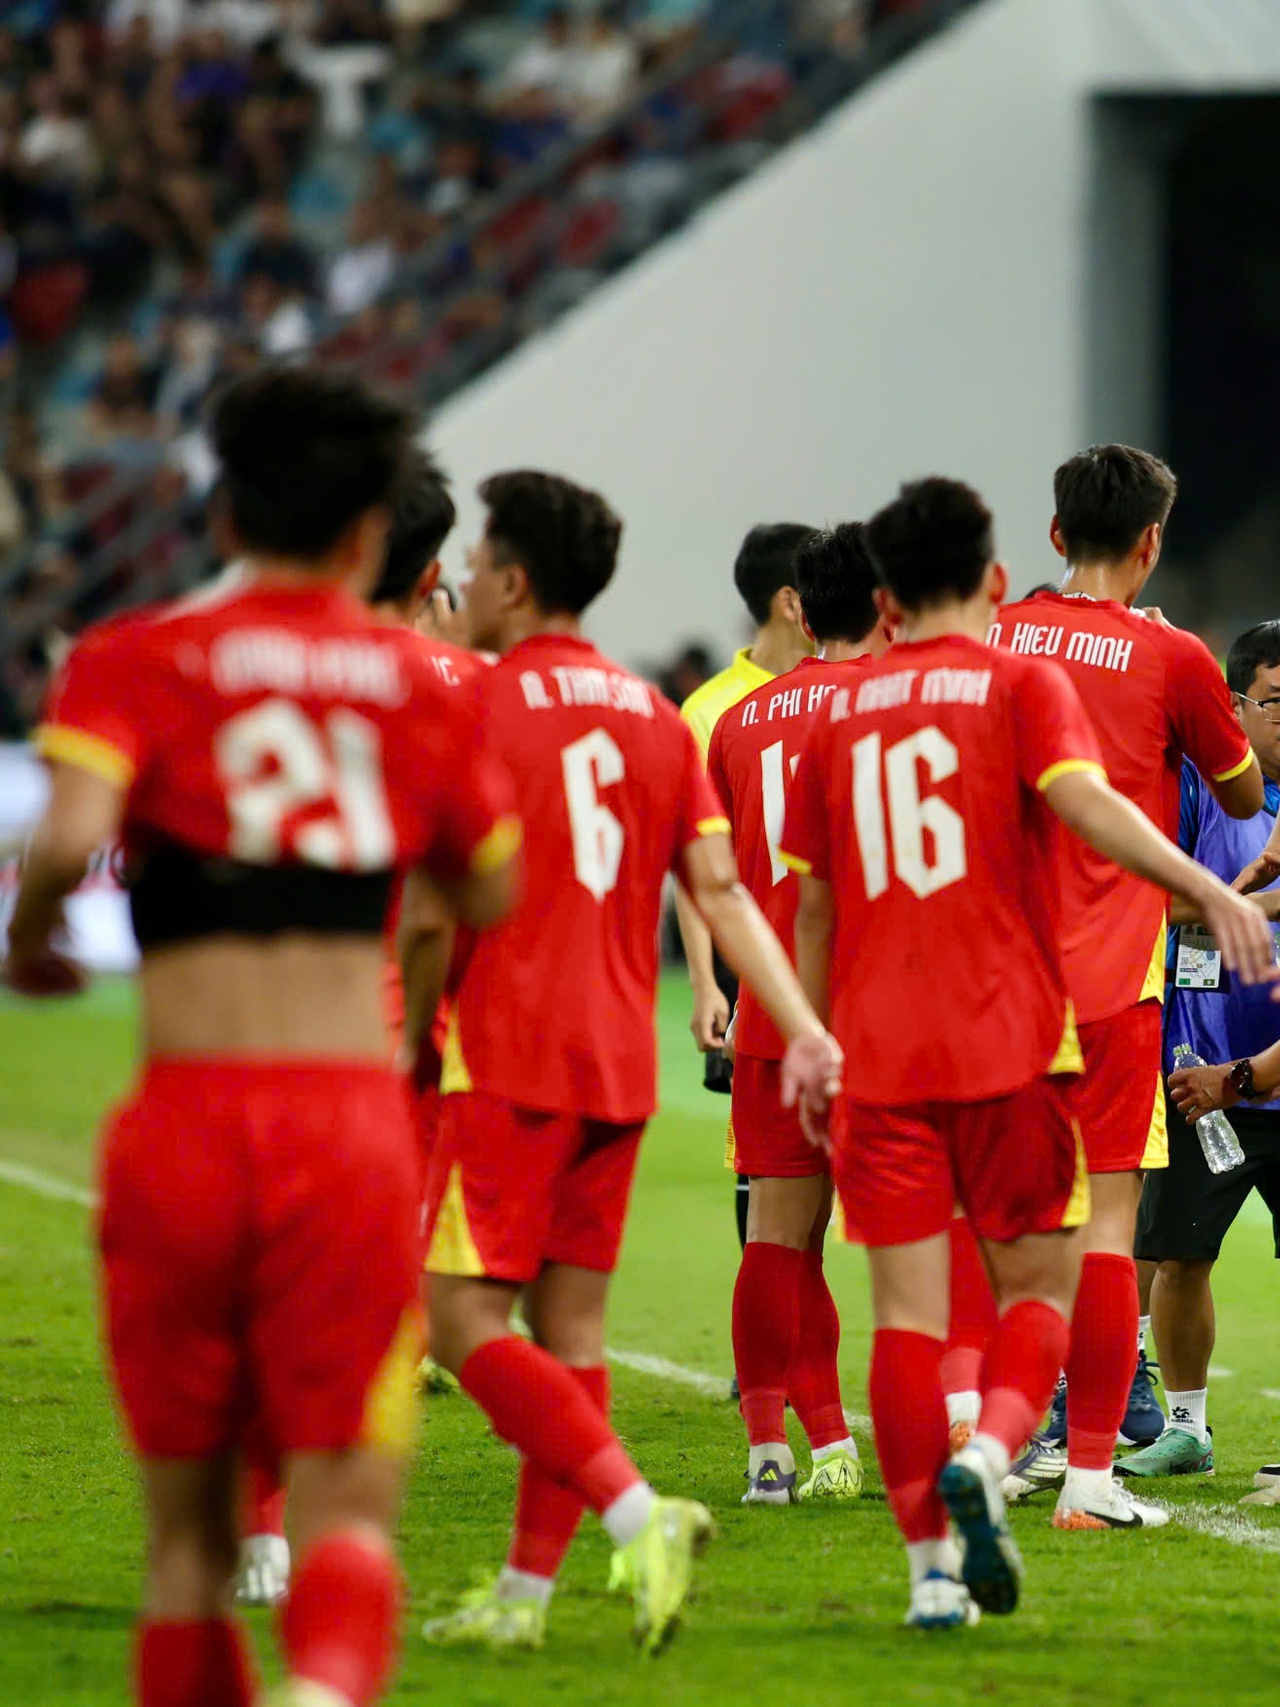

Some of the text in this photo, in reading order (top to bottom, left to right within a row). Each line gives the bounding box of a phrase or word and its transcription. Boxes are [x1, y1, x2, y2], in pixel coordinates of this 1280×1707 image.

[767, 687, 803, 721] PHI
[1010, 621, 1064, 656] HIEU
[1065, 631, 1133, 672] MINH
[214, 697, 397, 872] 21
[561, 724, 626, 903] 6
[852, 725, 969, 902] 16
